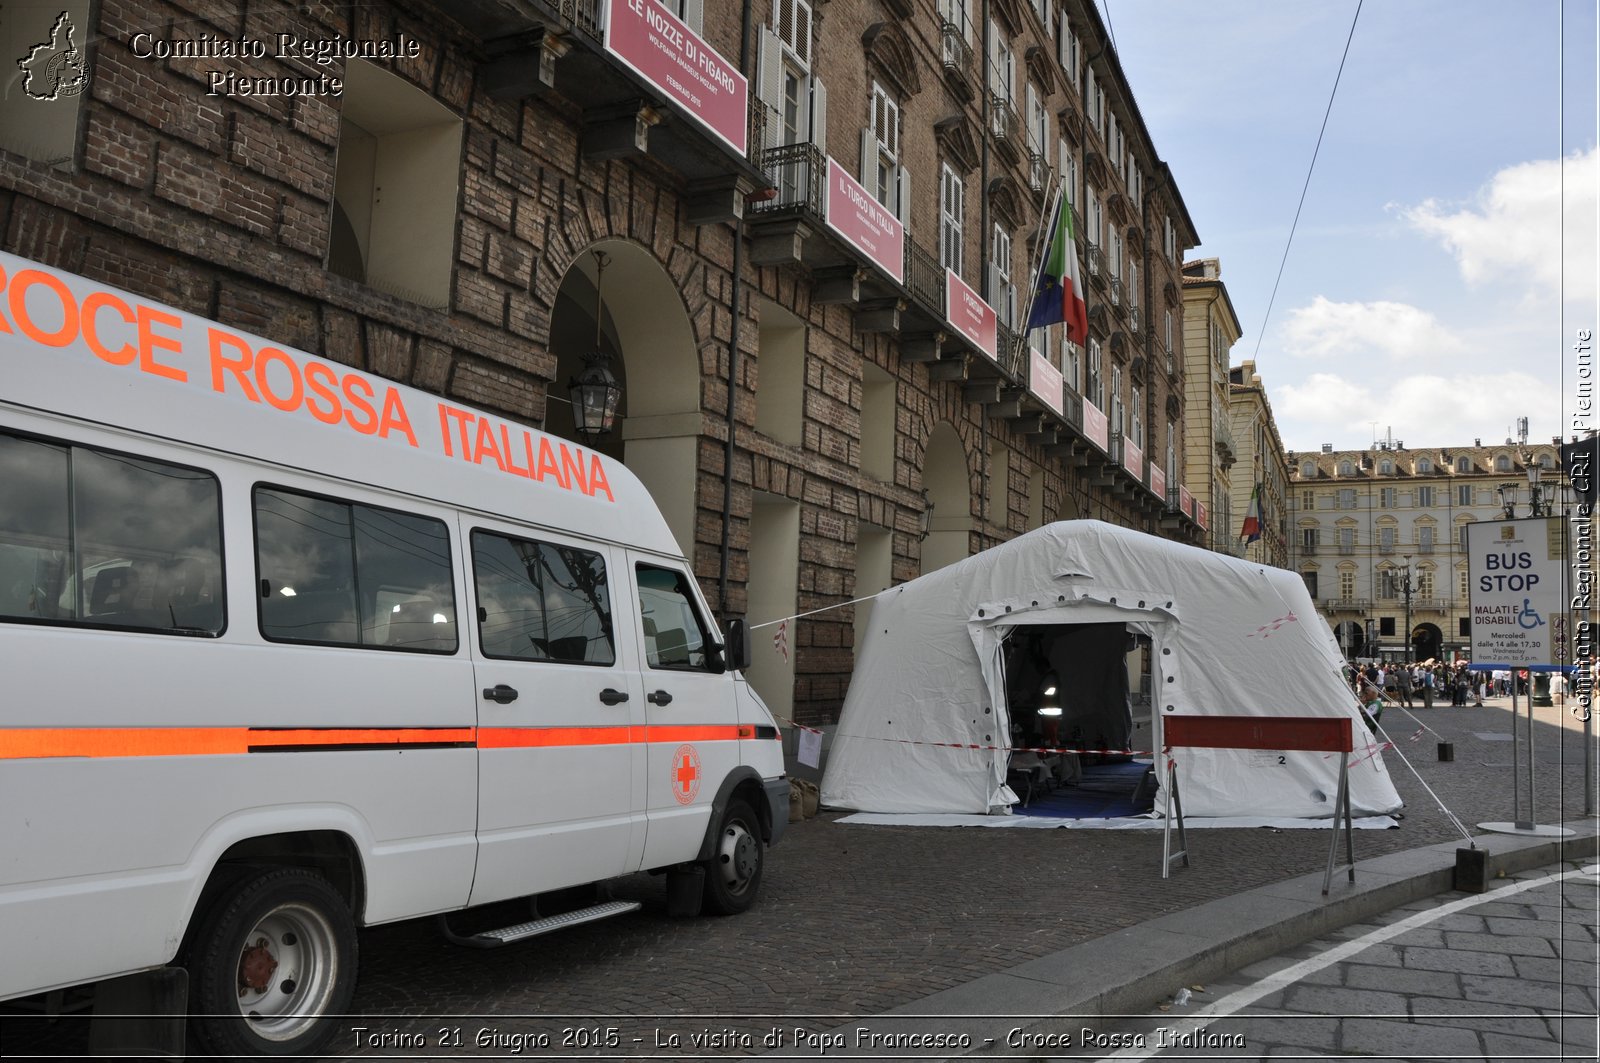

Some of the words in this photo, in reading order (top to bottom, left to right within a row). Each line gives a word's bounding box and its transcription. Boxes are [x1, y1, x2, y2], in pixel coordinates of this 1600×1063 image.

[646, 6, 683, 51] NOZZE
[686, 39, 697, 63] DI
[699, 53, 735, 95] FIGARO
[648, 32, 677, 61] WOLFGANG
[676, 56, 700, 80] AMADEUS
[699, 75, 718, 96] MOZART
[839, 176, 847, 195] IL
[847, 184, 868, 213] TURCO
[869, 204, 876, 221] IN
[876, 212, 895, 238] ITALIA
[0, 262, 189, 384] OCE
[207, 326, 419, 449] ROSSA
[438, 402, 615, 502] ITALIANA
[1486, 552, 1532, 570] BUS
[1480, 574, 1540, 592] STOP
[1474, 606, 1511, 615] MALATI
[1513, 605, 1519, 614] E
[1475, 616, 1516, 625] DISABILI
[1278, 756, 1286, 765] 2
